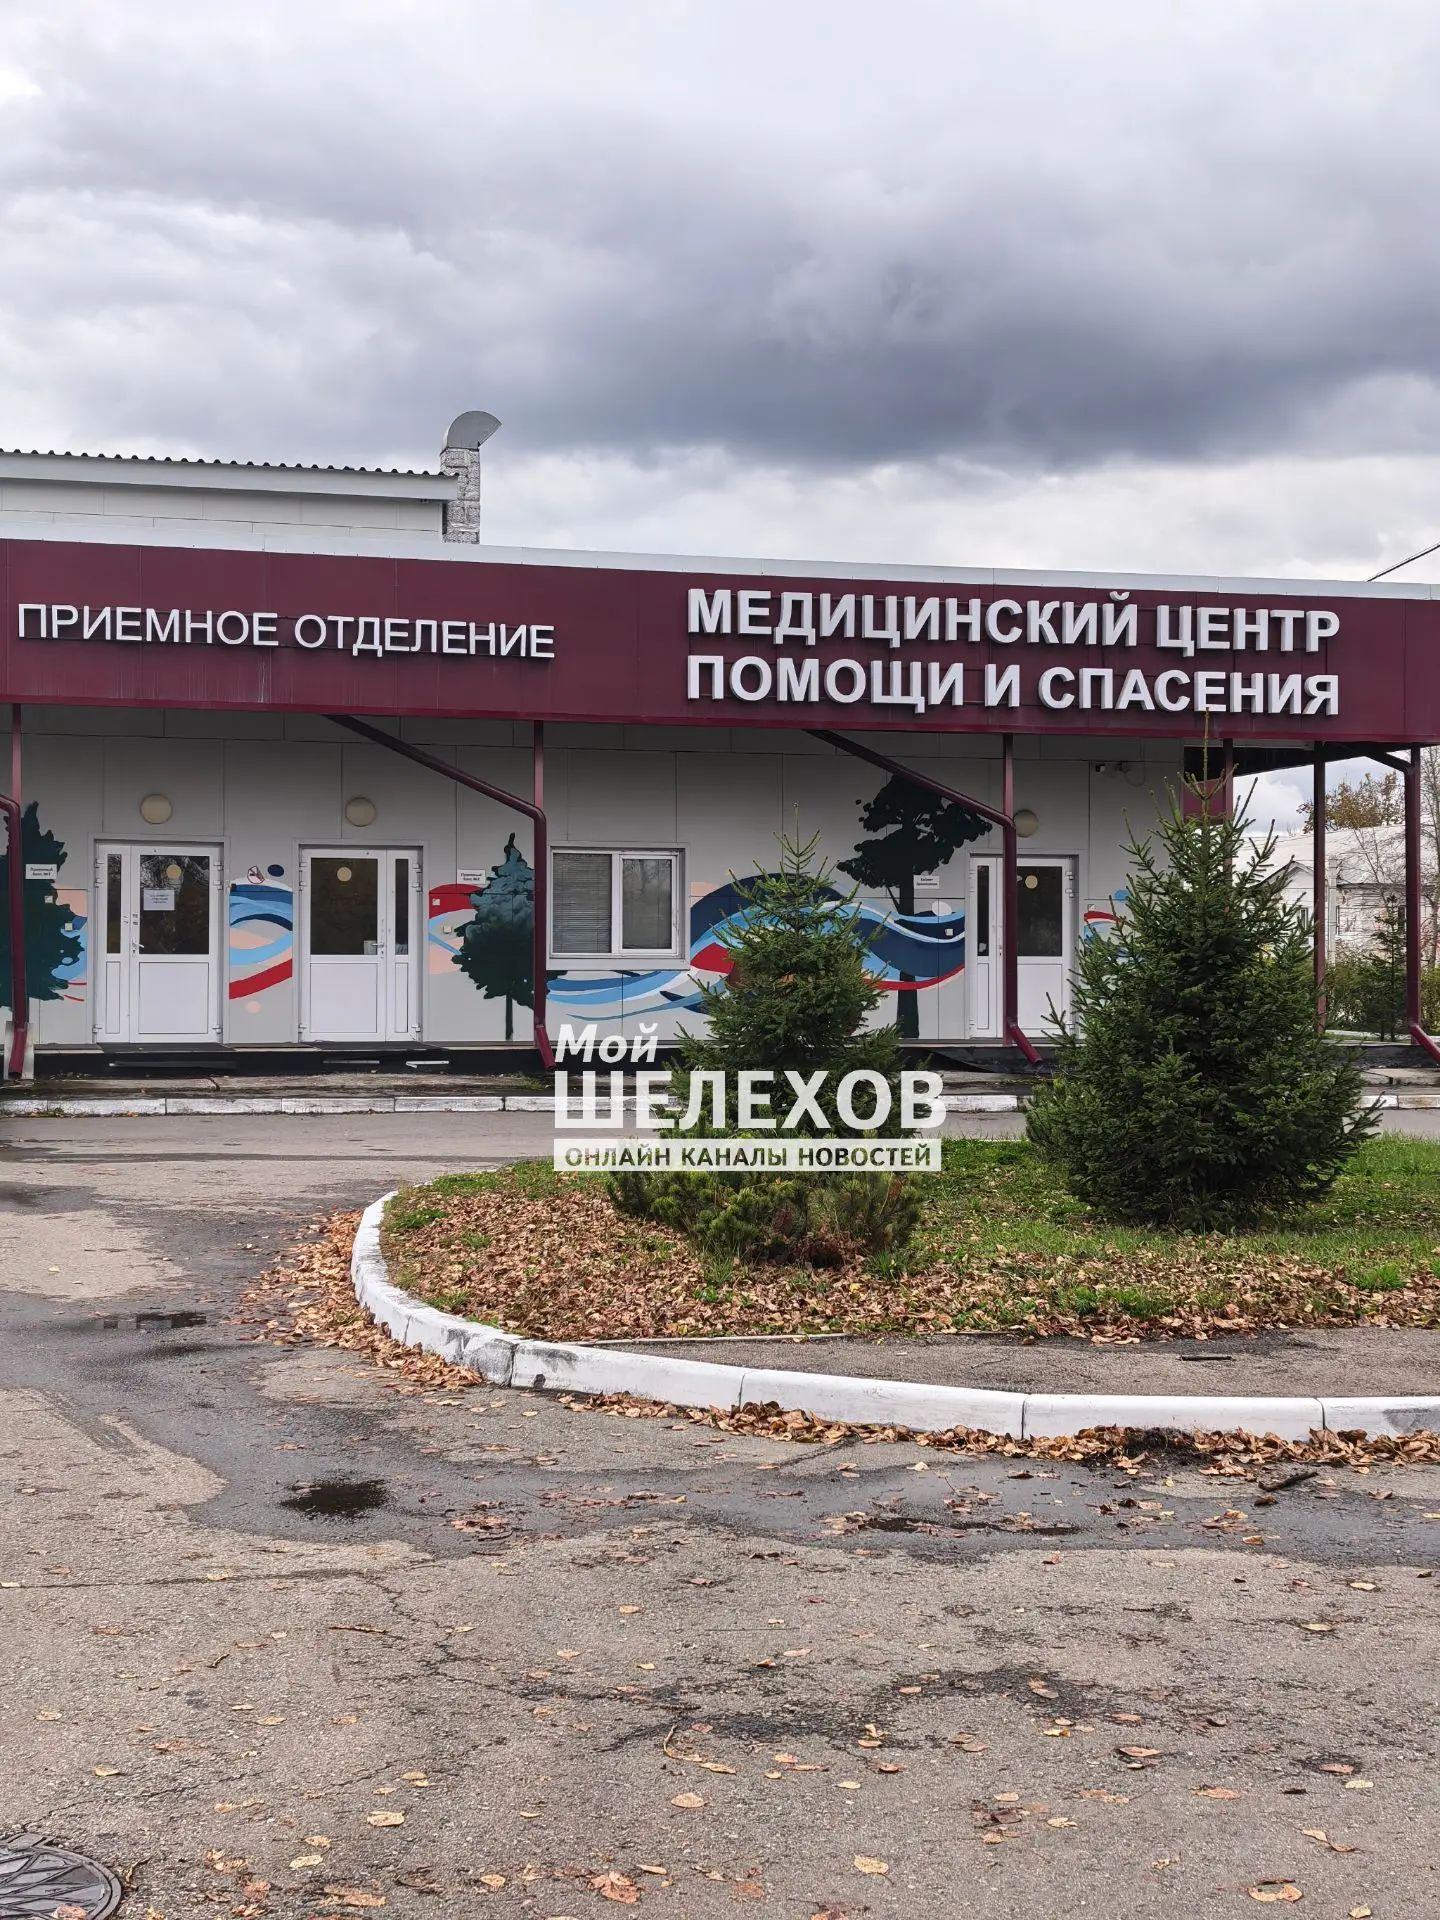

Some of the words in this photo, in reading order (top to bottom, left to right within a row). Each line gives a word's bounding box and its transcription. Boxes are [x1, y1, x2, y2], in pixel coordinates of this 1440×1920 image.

[18, 603, 279, 646] ПРИЕМНОЕ
[294, 614, 555, 658] ОТДЕЛЕНИЕ
[687, 588, 1138, 648] МЕДИЦИНСКИЙ
[1156, 604, 1341, 658] ЦЕНТР
[687, 655, 964, 714] ПОМОЩИ
[984, 663, 1021, 708] И
[1037, 666, 1339, 716] СПАСЕНИЯ
